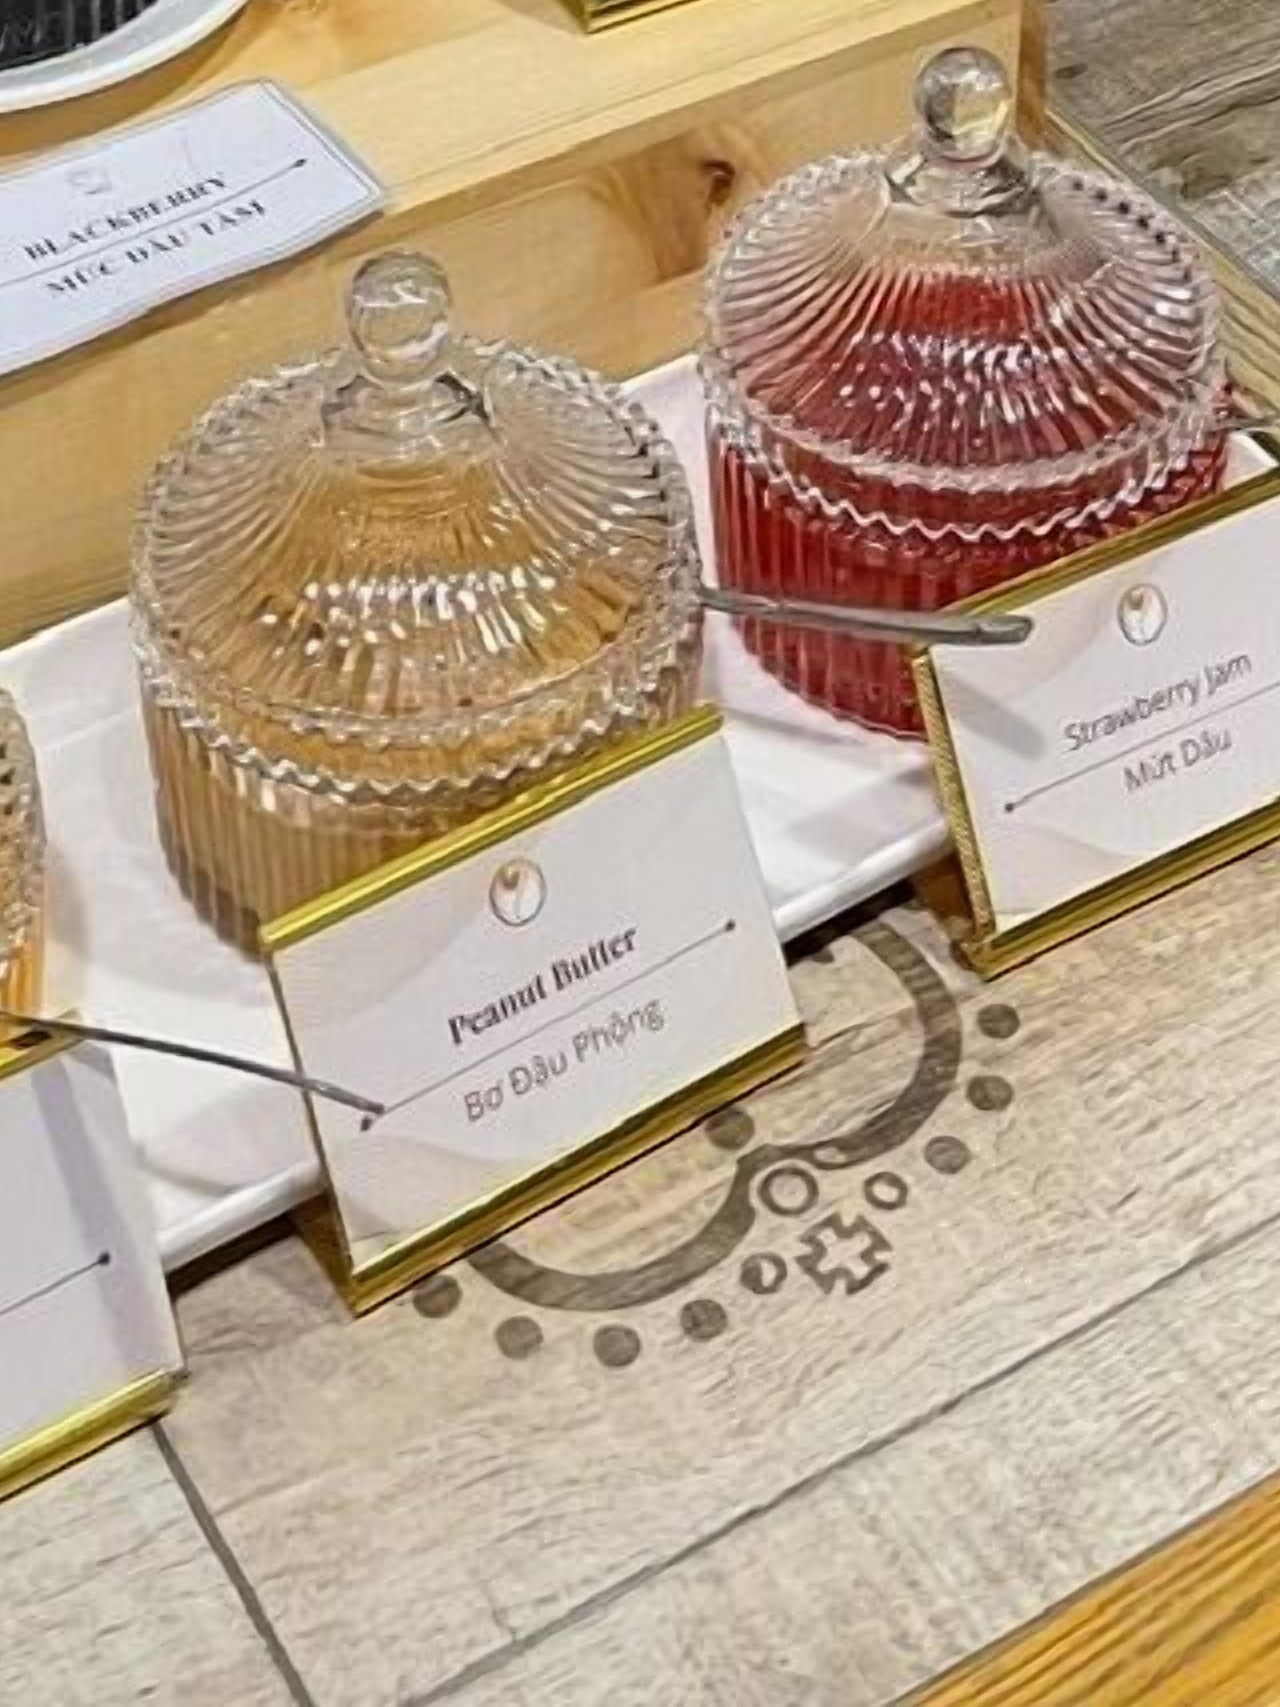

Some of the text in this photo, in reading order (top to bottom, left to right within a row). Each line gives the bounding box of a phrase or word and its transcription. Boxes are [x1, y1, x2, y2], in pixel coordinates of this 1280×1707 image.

[23, 177, 227, 260] BLACKBERRY
[1064, 679, 1200, 752] Strawberry
[448, 927, 637, 1046] Peanut Butter
[463, 1078, 505, 1122] Bơ
